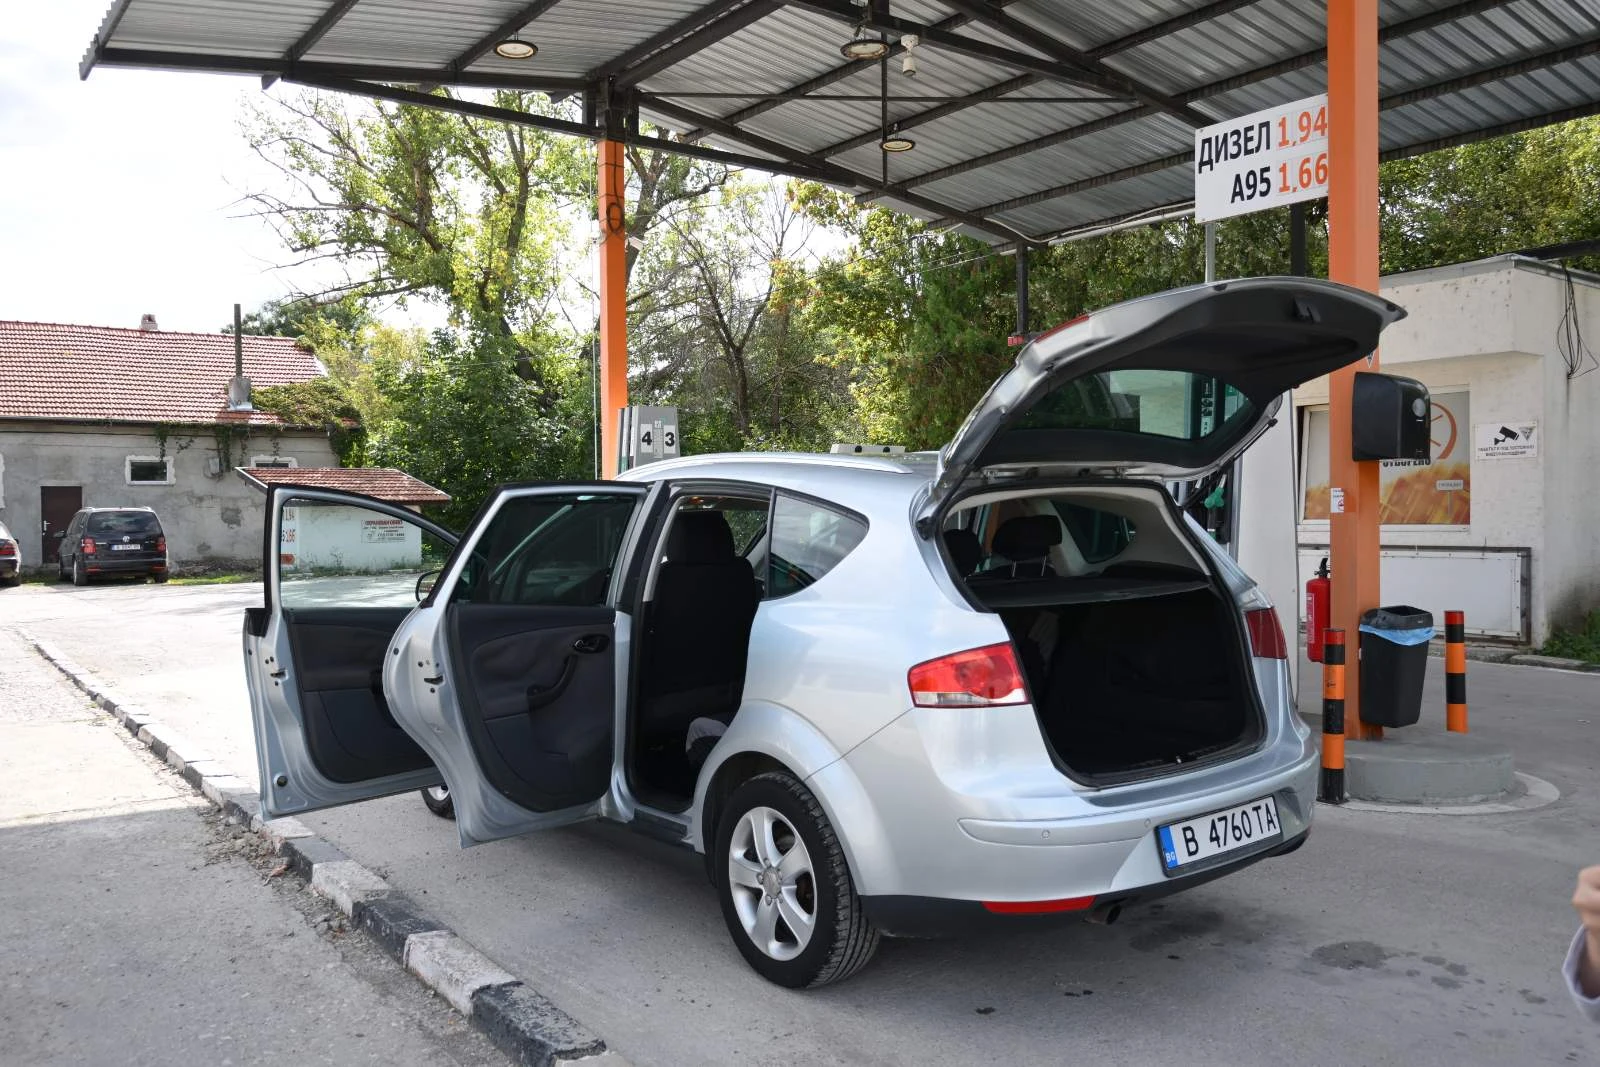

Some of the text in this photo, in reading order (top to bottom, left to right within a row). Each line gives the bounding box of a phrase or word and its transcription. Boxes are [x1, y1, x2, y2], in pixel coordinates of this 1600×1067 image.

[1198, 106, 1328, 174] ДИЗЕЛ 1.94
[1230, 153, 1328, 204] А95 1.66
[642, 431, 652, 445] 4
[665, 432, 674, 447] 3
[1165, 803, 1277, 863] BG B 4760 TA
